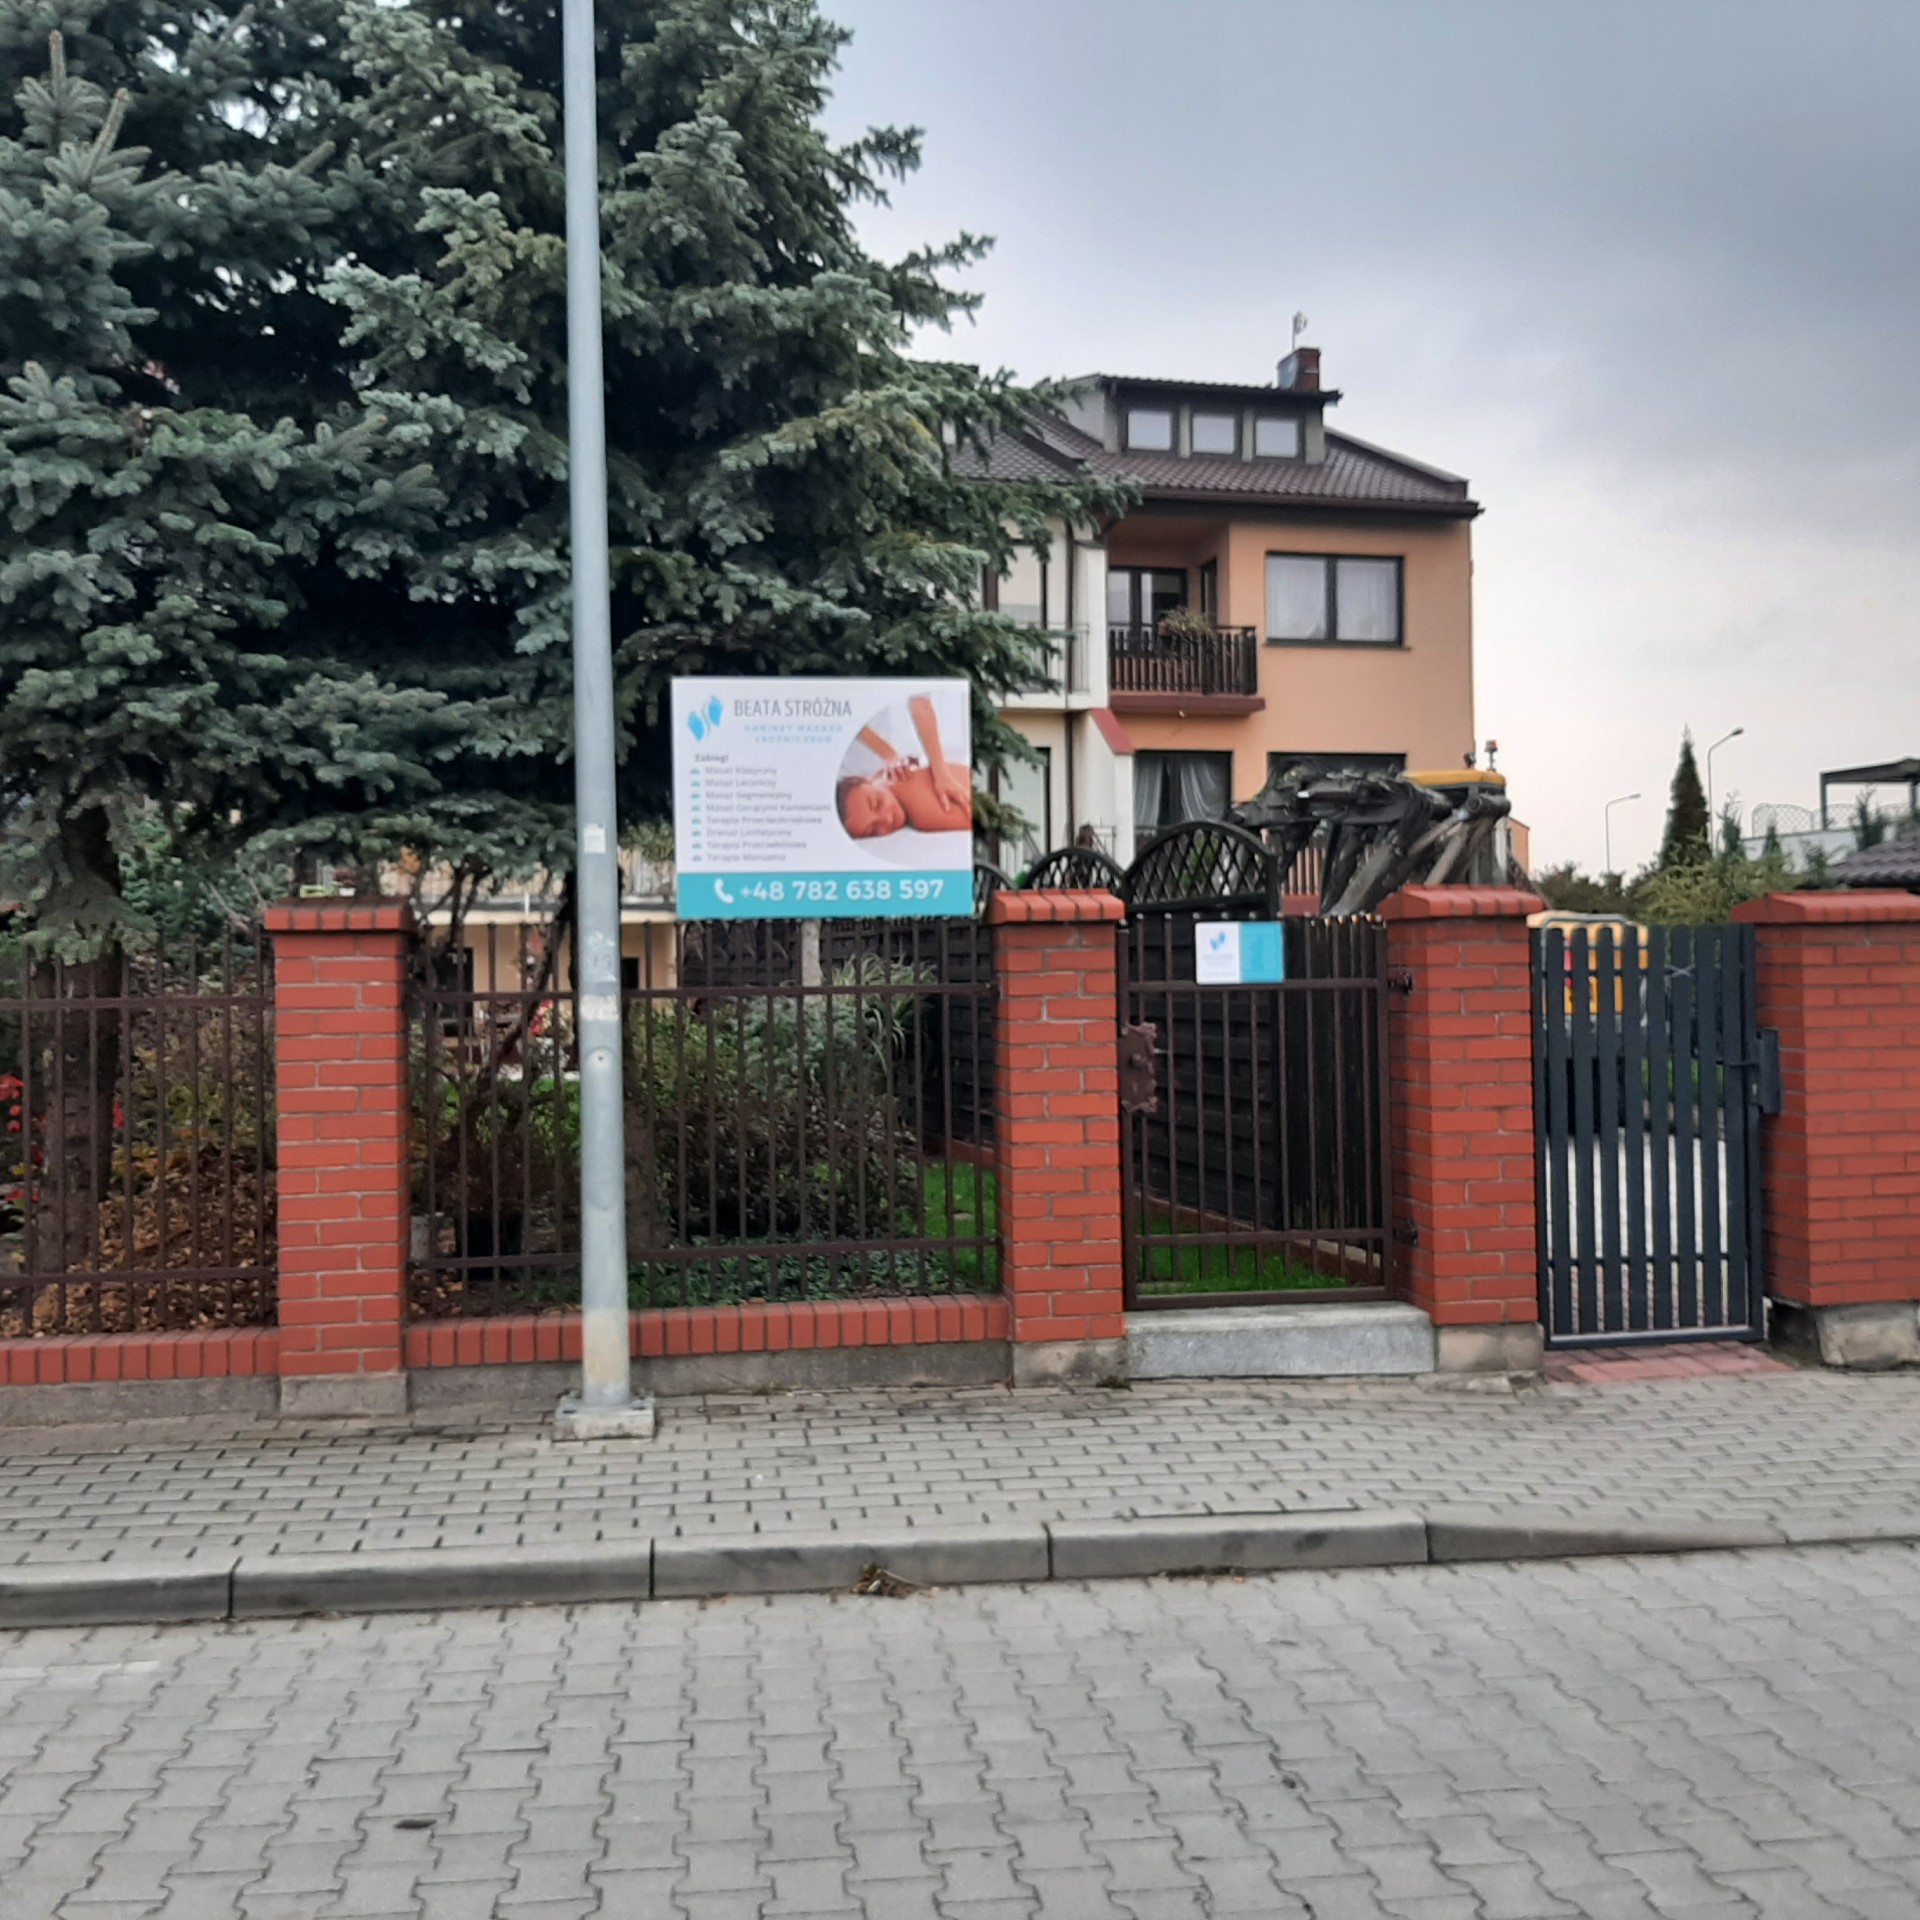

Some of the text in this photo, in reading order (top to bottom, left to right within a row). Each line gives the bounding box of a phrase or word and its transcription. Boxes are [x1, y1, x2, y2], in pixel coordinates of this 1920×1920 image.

[734, 696, 852, 718] BEATA STRÓŻNA
[741, 879, 945, 901] +48 782 638 597
